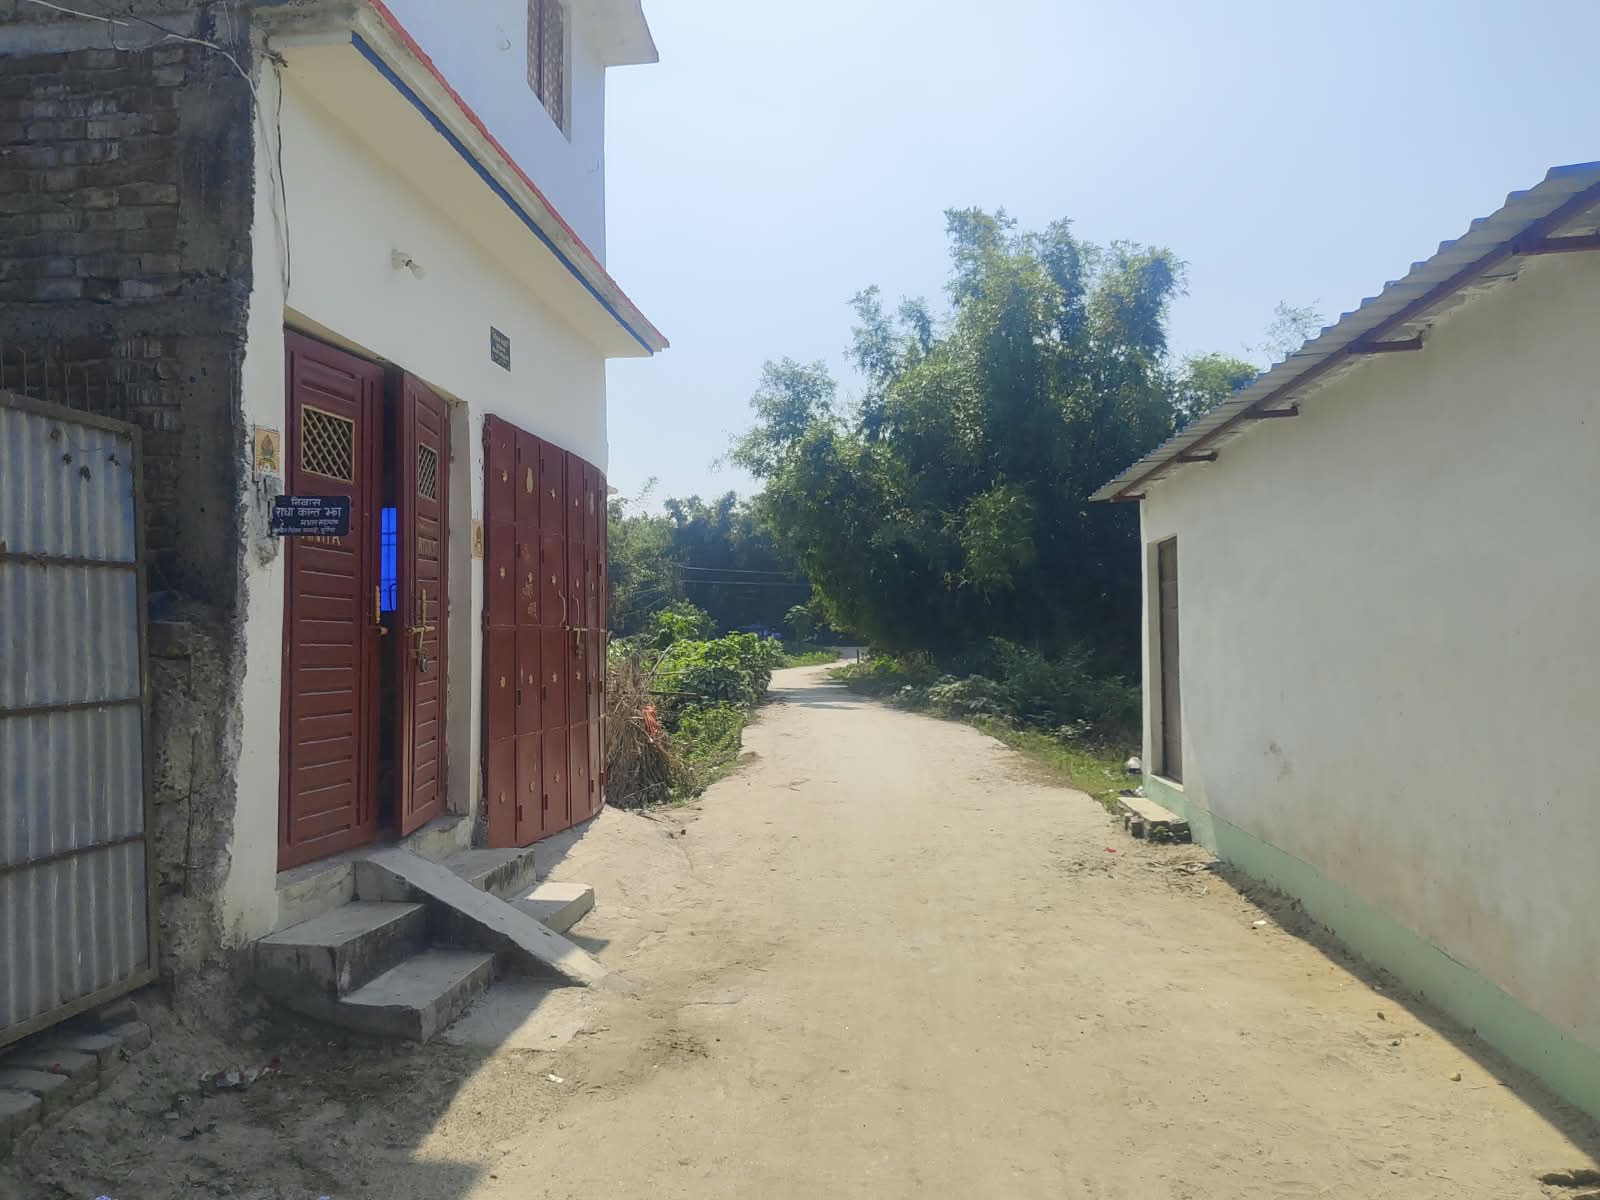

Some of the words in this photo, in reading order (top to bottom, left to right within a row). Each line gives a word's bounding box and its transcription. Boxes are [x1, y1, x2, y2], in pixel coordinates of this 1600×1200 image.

[291, 496, 321, 506] निवास
[275, 507, 295, 518] राधा
[297, 507, 321, 517] कान्त
